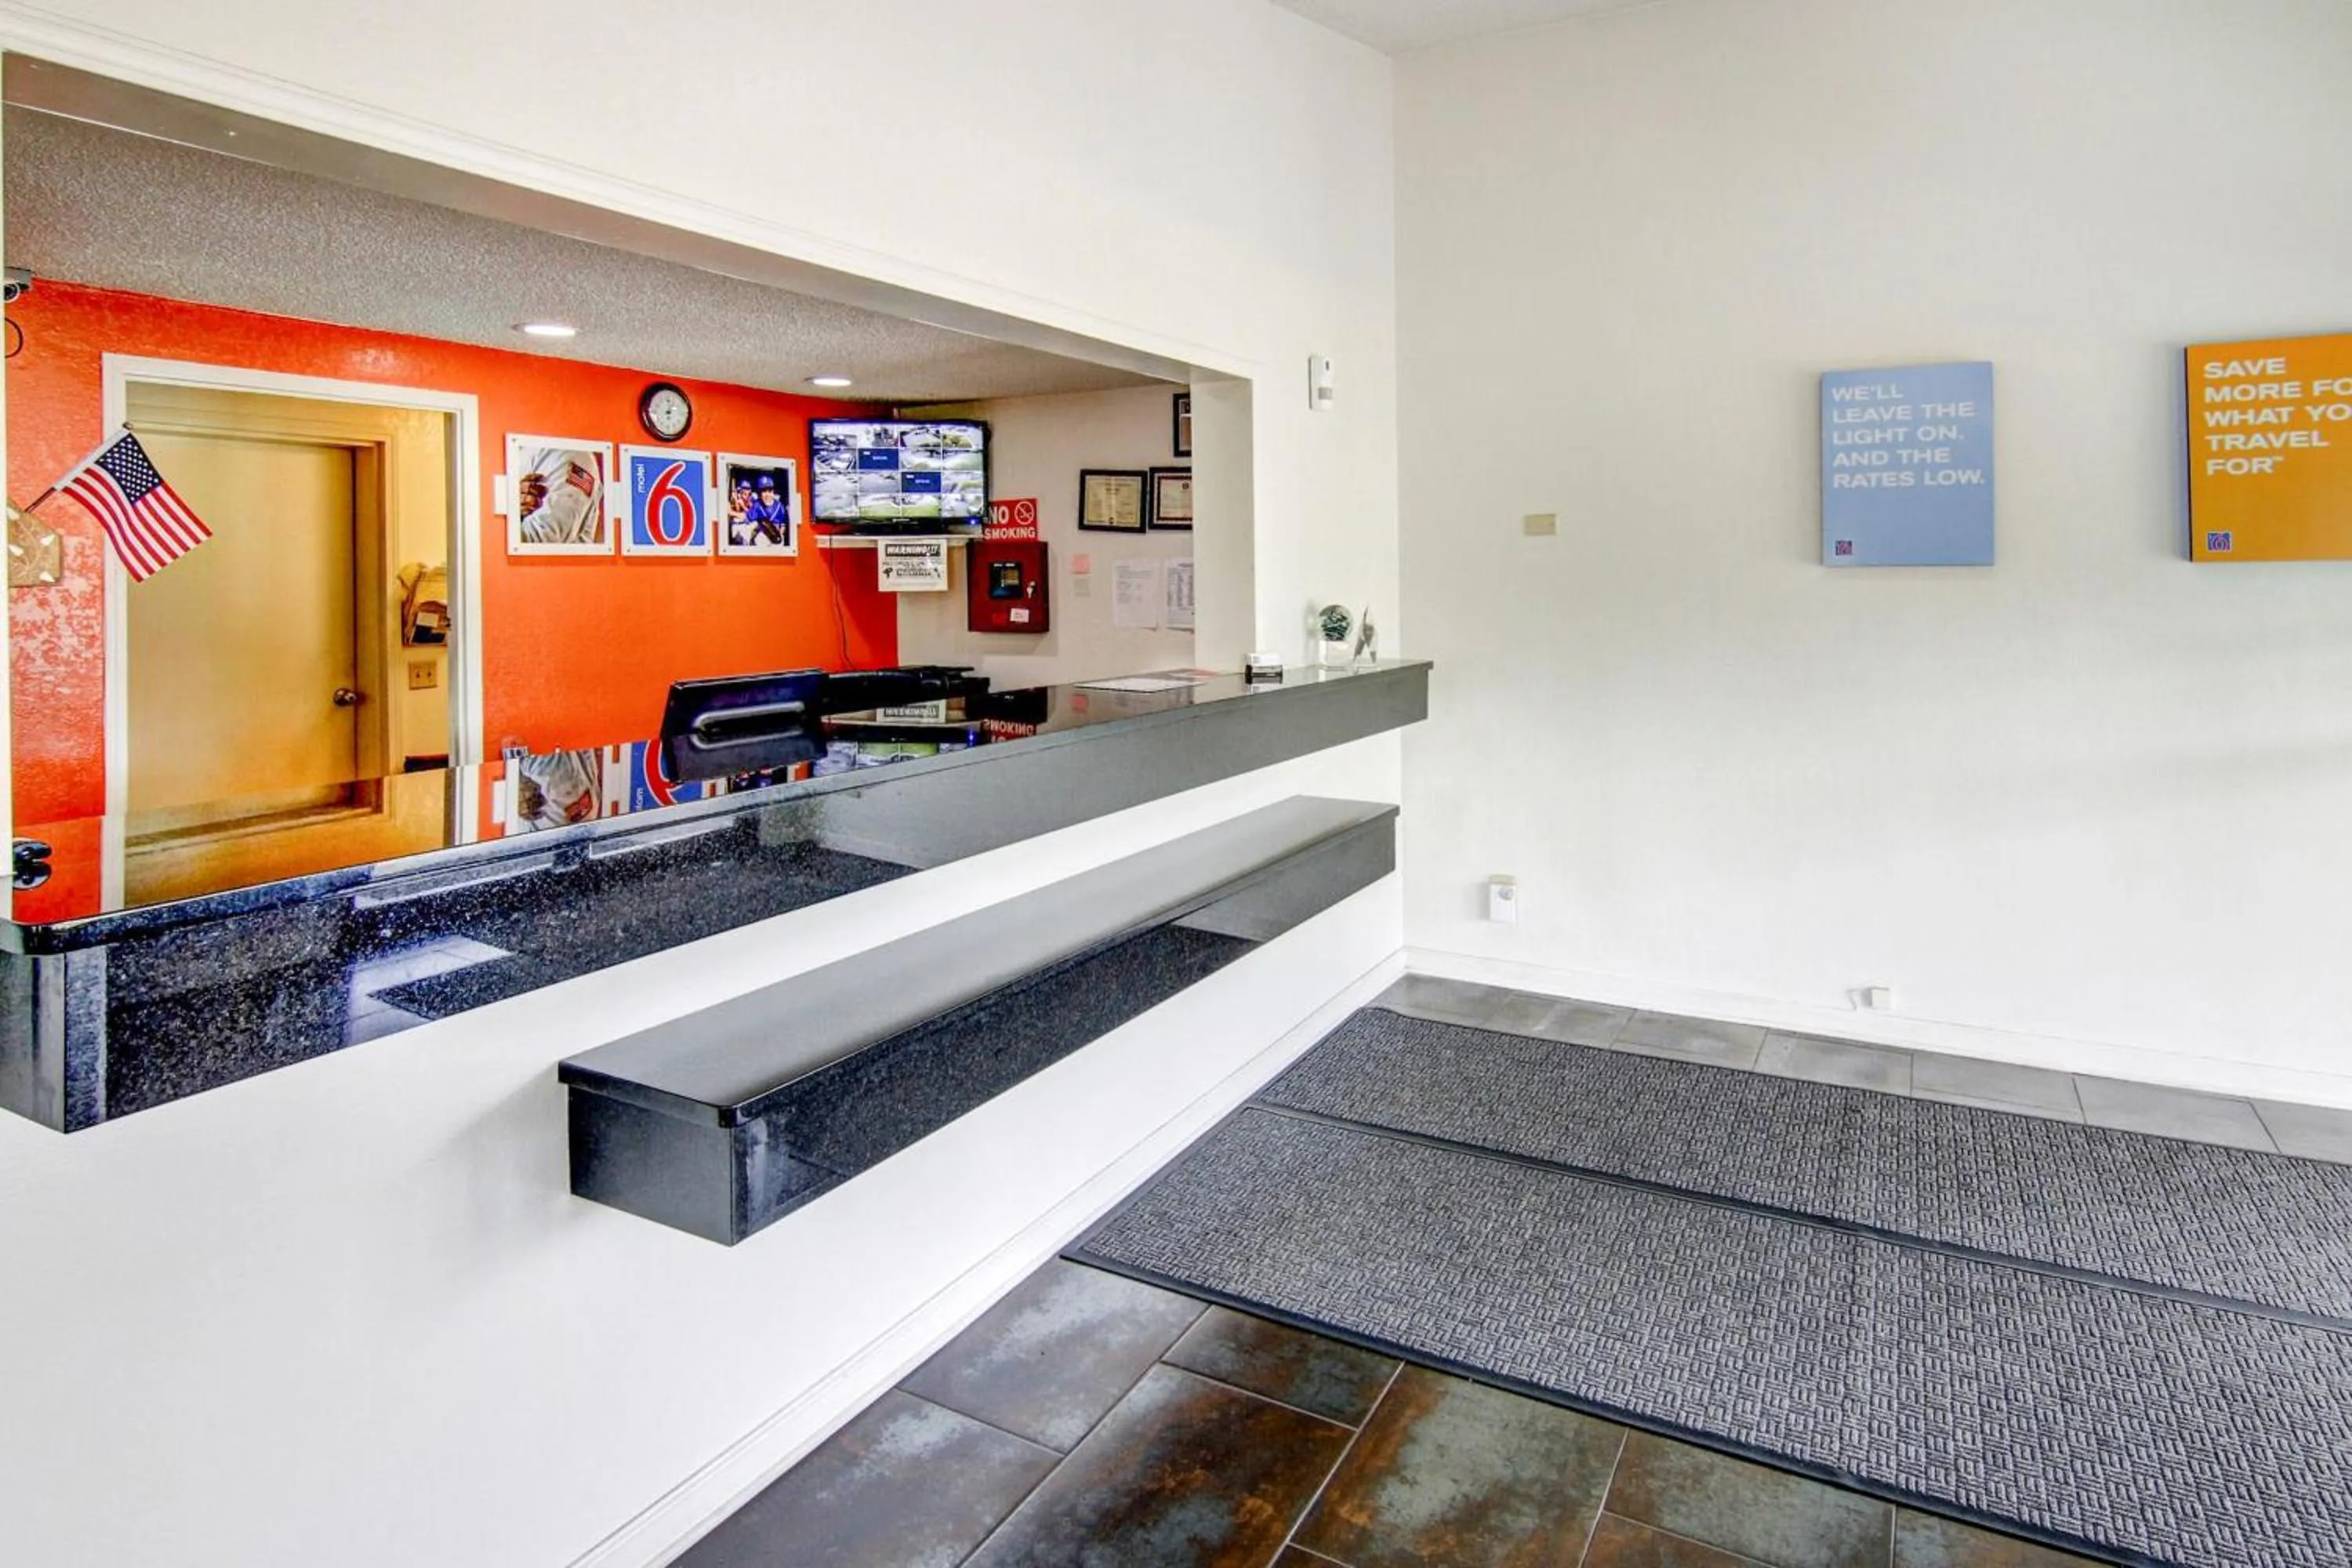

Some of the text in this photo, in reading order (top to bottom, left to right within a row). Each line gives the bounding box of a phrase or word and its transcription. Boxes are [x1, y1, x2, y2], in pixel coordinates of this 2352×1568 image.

[2204, 358, 2286, 379] SAVE
[1832, 384, 1904, 401] WE'LL
[2205, 377, 2352, 403] MORE FO
[1833, 401, 1976, 423] LEAVE THE
[2205, 404, 2352, 426] WHAT YO
[1833, 425, 1964, 445] LIGHT ON.
[2205, 430, 2331, 452] TRAVEL
[1833, 448, 1951, 468] AND THE
[1833, 469, 1984, 488] RATES LOW.
[645, 461, 696, 546] 6
[989, 506, 1009, 524] NO
[984, 527, 1035, 539] SMOKING
